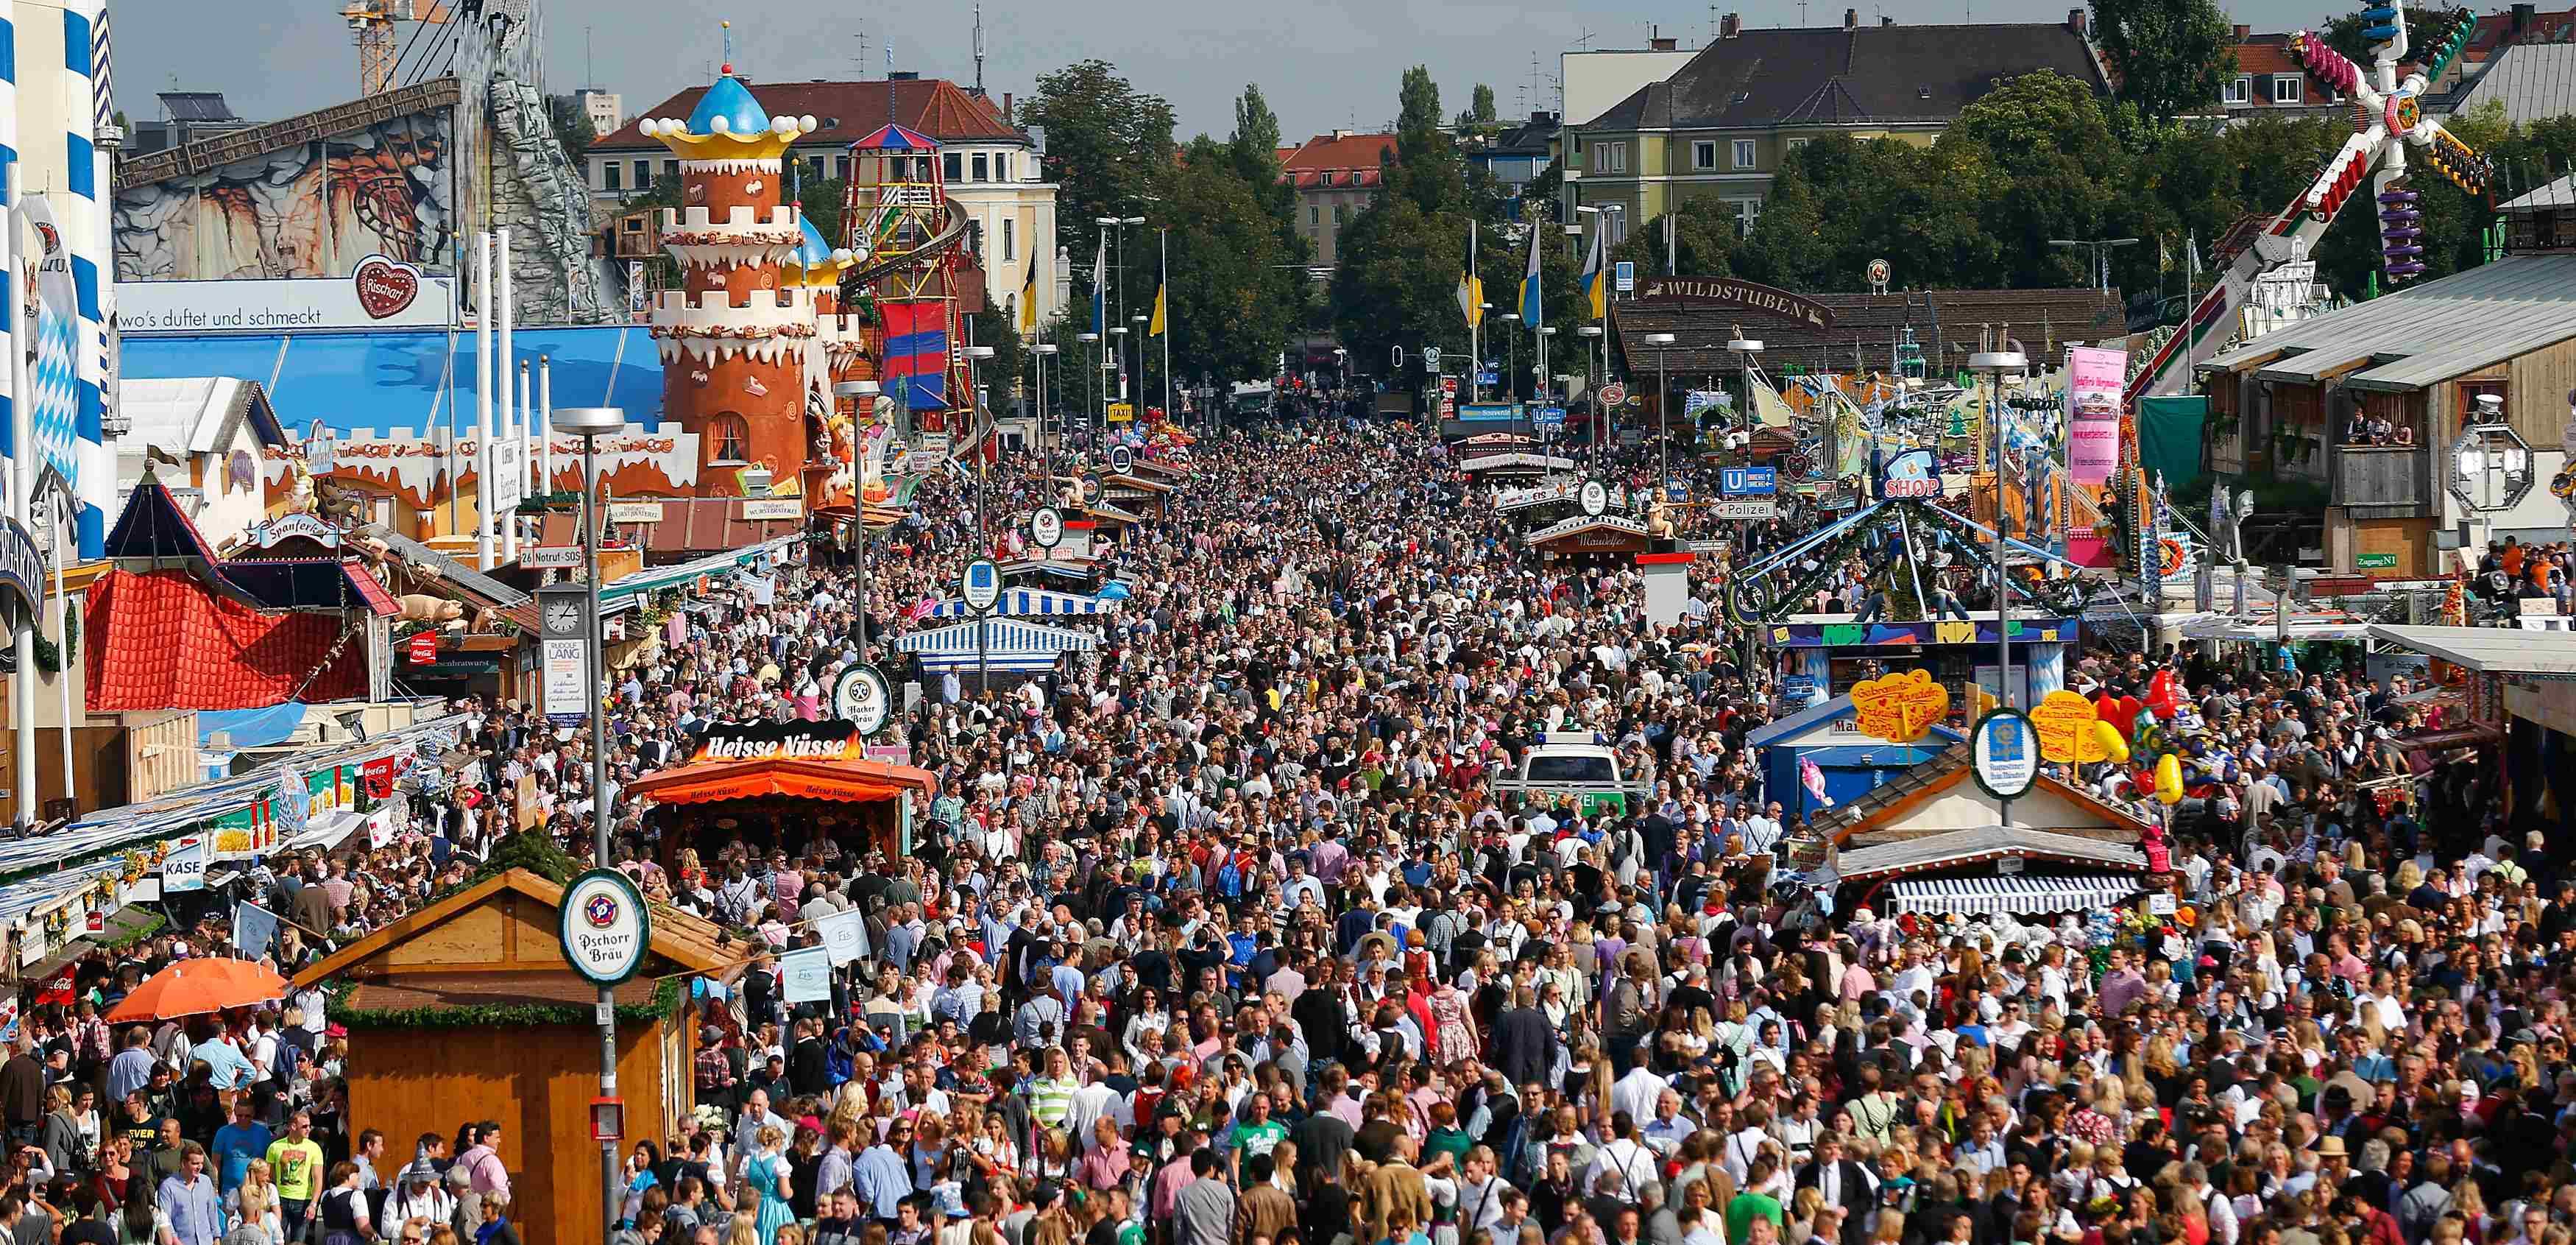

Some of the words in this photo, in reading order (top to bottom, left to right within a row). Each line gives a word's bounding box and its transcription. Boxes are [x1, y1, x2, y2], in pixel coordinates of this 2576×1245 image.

[367, 278, 406, 302] Rischart
[1666, 281, 1806, 318] WILDSTUBEN
[119, 310, 156, 328] wo's
[163, 308, 206, 327] duftet
[213, 307, 241, 325] und
[249, 306, 322, 325] schmeckt
[1112, 409, 1128, 417] TAXI
[1535, 410, 1544, 420] U
[1669, 482, 1685, 490] WC
[1727, 473, 1743, 489] U
[1885, 479, 1940, 498] SHOP
[1727, 504, 1769, 515] Polizei
[269, 518, 328, 540] Spanferk
[522, 553, 531, 562] 26
[2357, 557, 2384, 566] Zugang
[548, 648, 580, 660] LANG
[847, 705, 876, 714] Hacker
[706, 736, 779, 758] Heisse
[781, 735, 847, 758] Nüsse
[690, 790, 715, 800] Heisse
[716, 786, 740, 797] Nüsse
[805, 785, 832, 796] Heisse
[832, 787, 856, 798] Nüsse
[165, 859, 201, 875] KÄSE
[578, 933, 631, 949] Pschorr
[589, 947, 623, 963] Bräu
